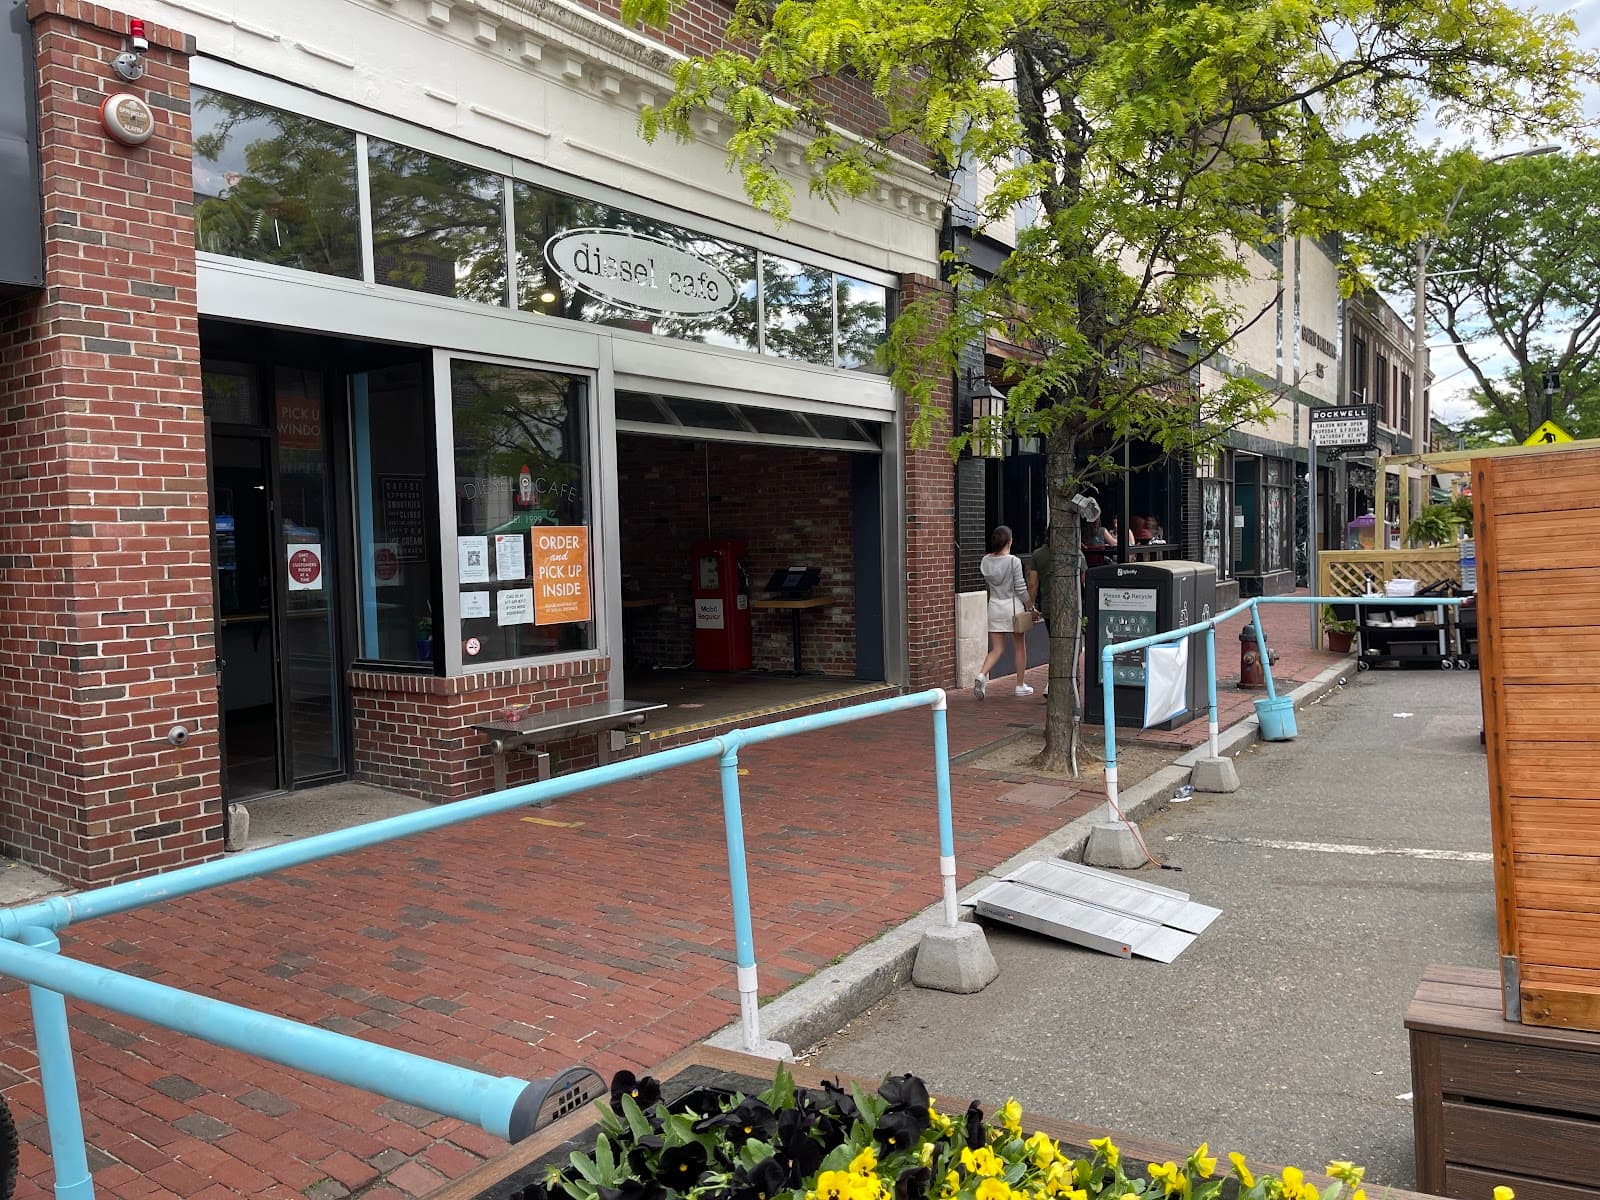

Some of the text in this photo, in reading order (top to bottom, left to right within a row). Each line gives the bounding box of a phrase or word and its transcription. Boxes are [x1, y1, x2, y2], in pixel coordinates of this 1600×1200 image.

[573, 242, 657, 289] diesel
[281, 407, 308, 420] PICK
[1313, 409, 1367, 419] ROCKWELL
[464, 477, 577, 503] DIESEL CAFE
[539, 535, 580, 550] ORDER
[545, 550, 568, 563] and
[539, 564, 582, 580] PICK UP
[543, 582, 581, 598] INSIDE
